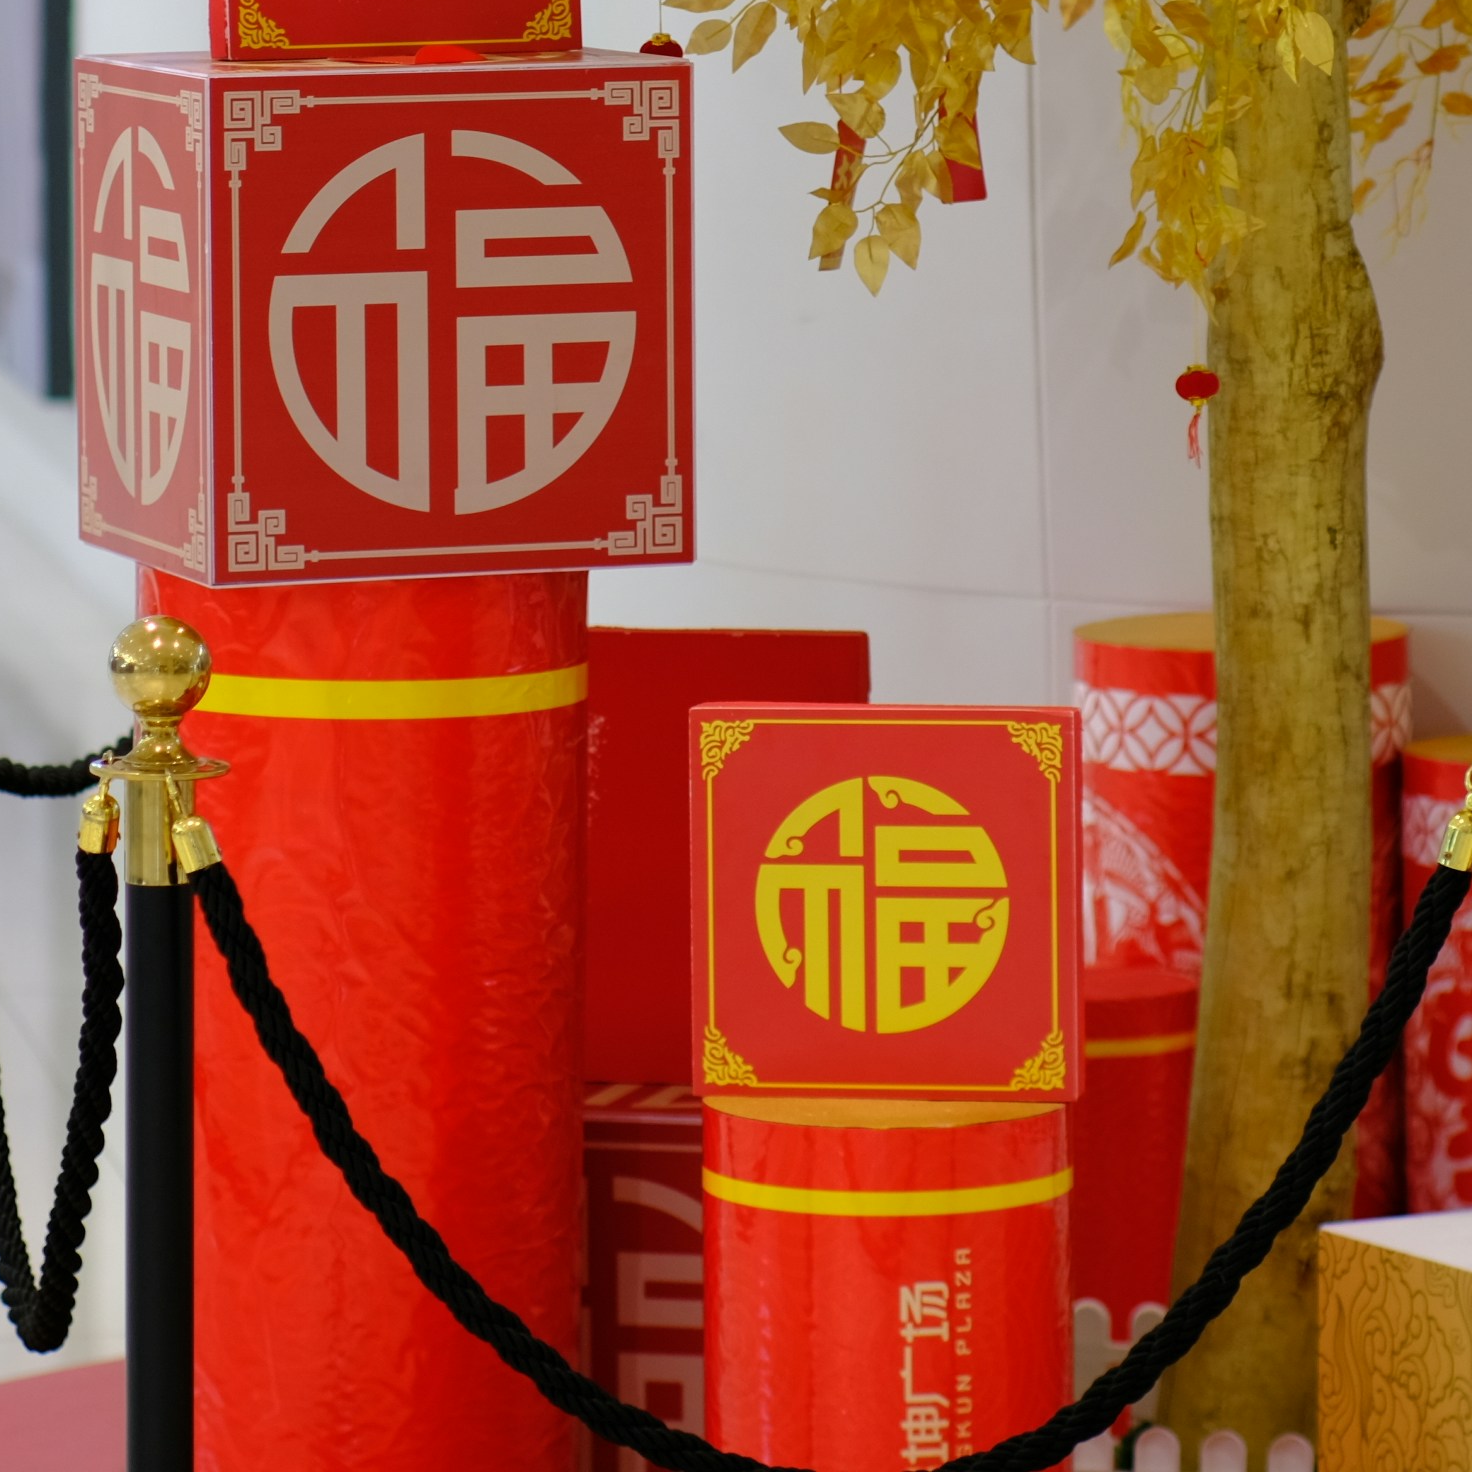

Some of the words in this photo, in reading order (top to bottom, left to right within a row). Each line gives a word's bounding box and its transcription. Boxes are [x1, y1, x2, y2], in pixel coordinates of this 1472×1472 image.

[90, 125, 192, 506] 福
[267, 129, 637, 516] 福
[754, 774, 1010, 1035] 福
[899, 1280, 950, 1472] 坤广场
[954, 1247, 972, 1356] PLAZA
